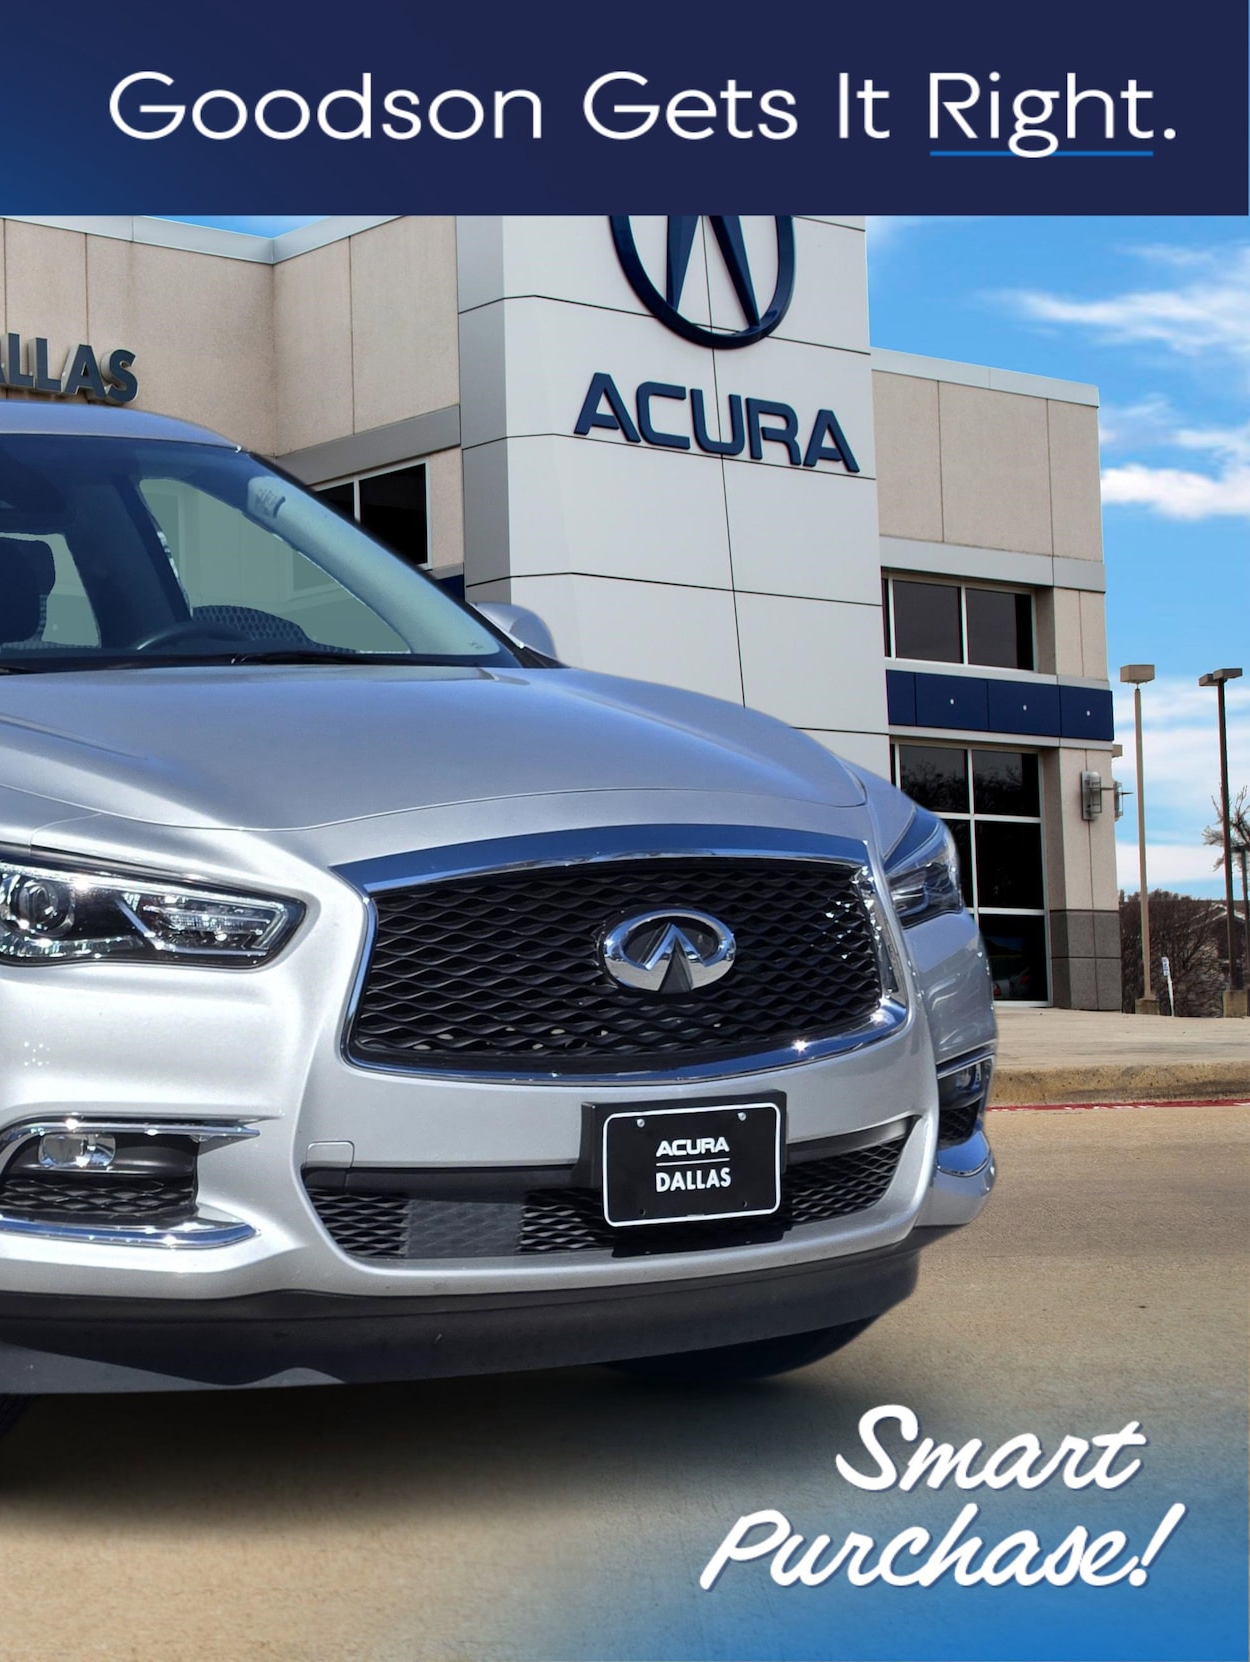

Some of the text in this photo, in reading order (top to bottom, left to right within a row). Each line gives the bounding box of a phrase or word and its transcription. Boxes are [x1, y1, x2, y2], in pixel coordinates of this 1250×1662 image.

[573, 372, 860, 473] ACURA
[655, 1136, 730, 1157] ACURA
[655, 1167, 732, 1193] DALLAS
